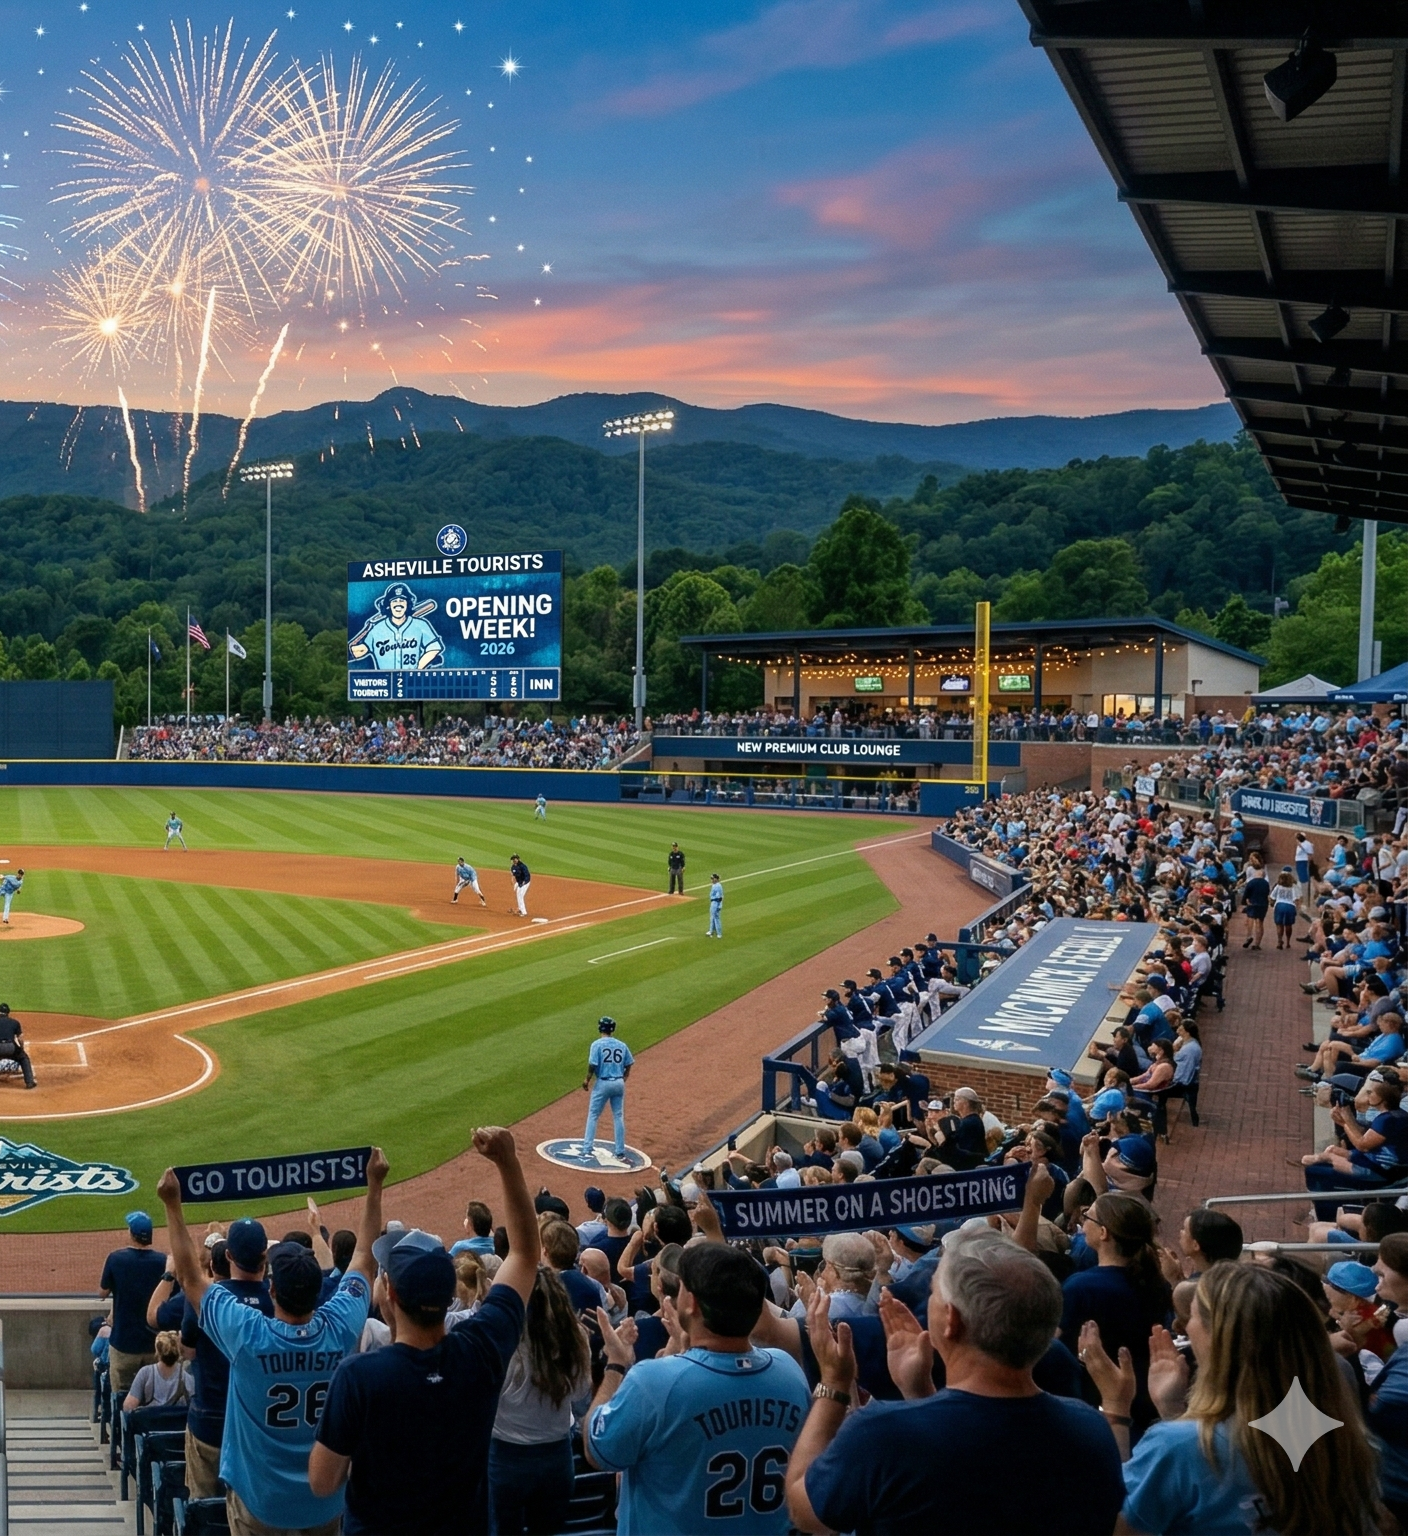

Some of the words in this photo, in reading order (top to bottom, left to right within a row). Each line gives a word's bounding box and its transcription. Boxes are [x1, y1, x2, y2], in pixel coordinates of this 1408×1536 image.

[362, 559, 452, 578] ASHEVILLE
[457, 554, 543, 573] TOURISTS
[445, 594, 552, 618] OPENING
[460, 618, 536, 640] WEEK!
[480, 642, 515, 655] 2026
[529, 679, 554, 690] INN
[737, 742, 762, 753] NEW
[765, 742, 817, 754] PREMIUM
[820, 743, 850, 755] CLUB
[853, 744, 901, 756] LOUNGE
[602, 1048, 623, 1063] 26
[187, 1170, 225, 1195] GO
[232, 1155, 364, 1191] TOURISTS!
[737, 1197, 828, 1228] SUMMER
[835, 1193, 864, 1219] ON
[870, 1191, 884, 1217] A
[889, 1174, 1016, 1216] SHOESTRING
[694, 1398, 800, 1441] TOURISTS
[704, 1445, 791, 1519] 26
